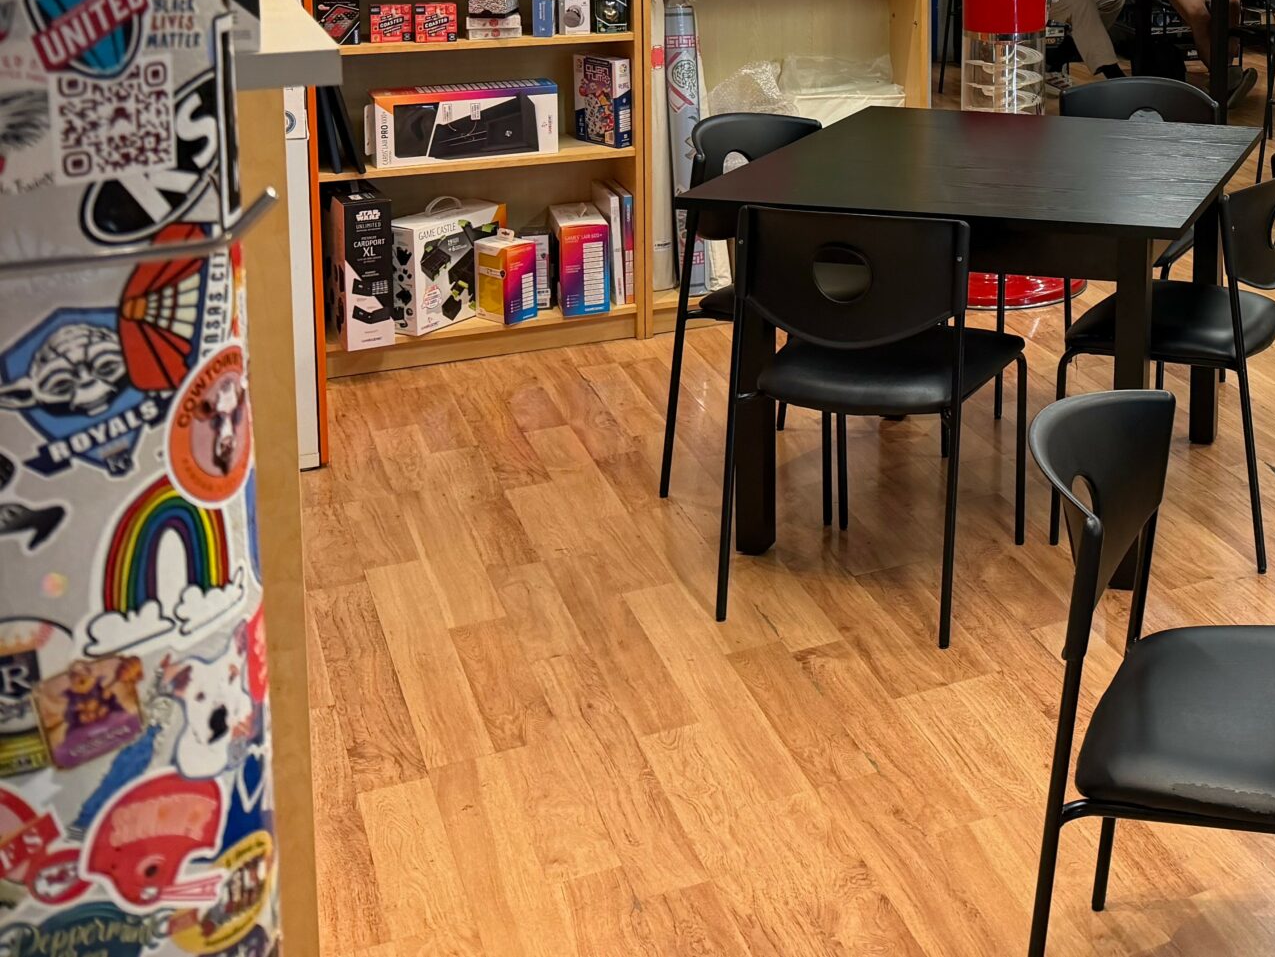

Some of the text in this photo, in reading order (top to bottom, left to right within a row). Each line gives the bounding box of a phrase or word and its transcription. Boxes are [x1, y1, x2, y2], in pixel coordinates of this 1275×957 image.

[151, 13, 195, 29] LIVES
[379, 16, 403, 29] COASTER
[424, 17, 448, 29] COASTER
[147, 32, 202, 49] MATTER
[380, 123, 389, 138] PRO
[418, 222, 456, 240] GAME CASTLE
[353, 238, 385, 248] CARDPORT
[363, 247, 376, 257] XL
[51, 401, 160, 462] ROYALS
